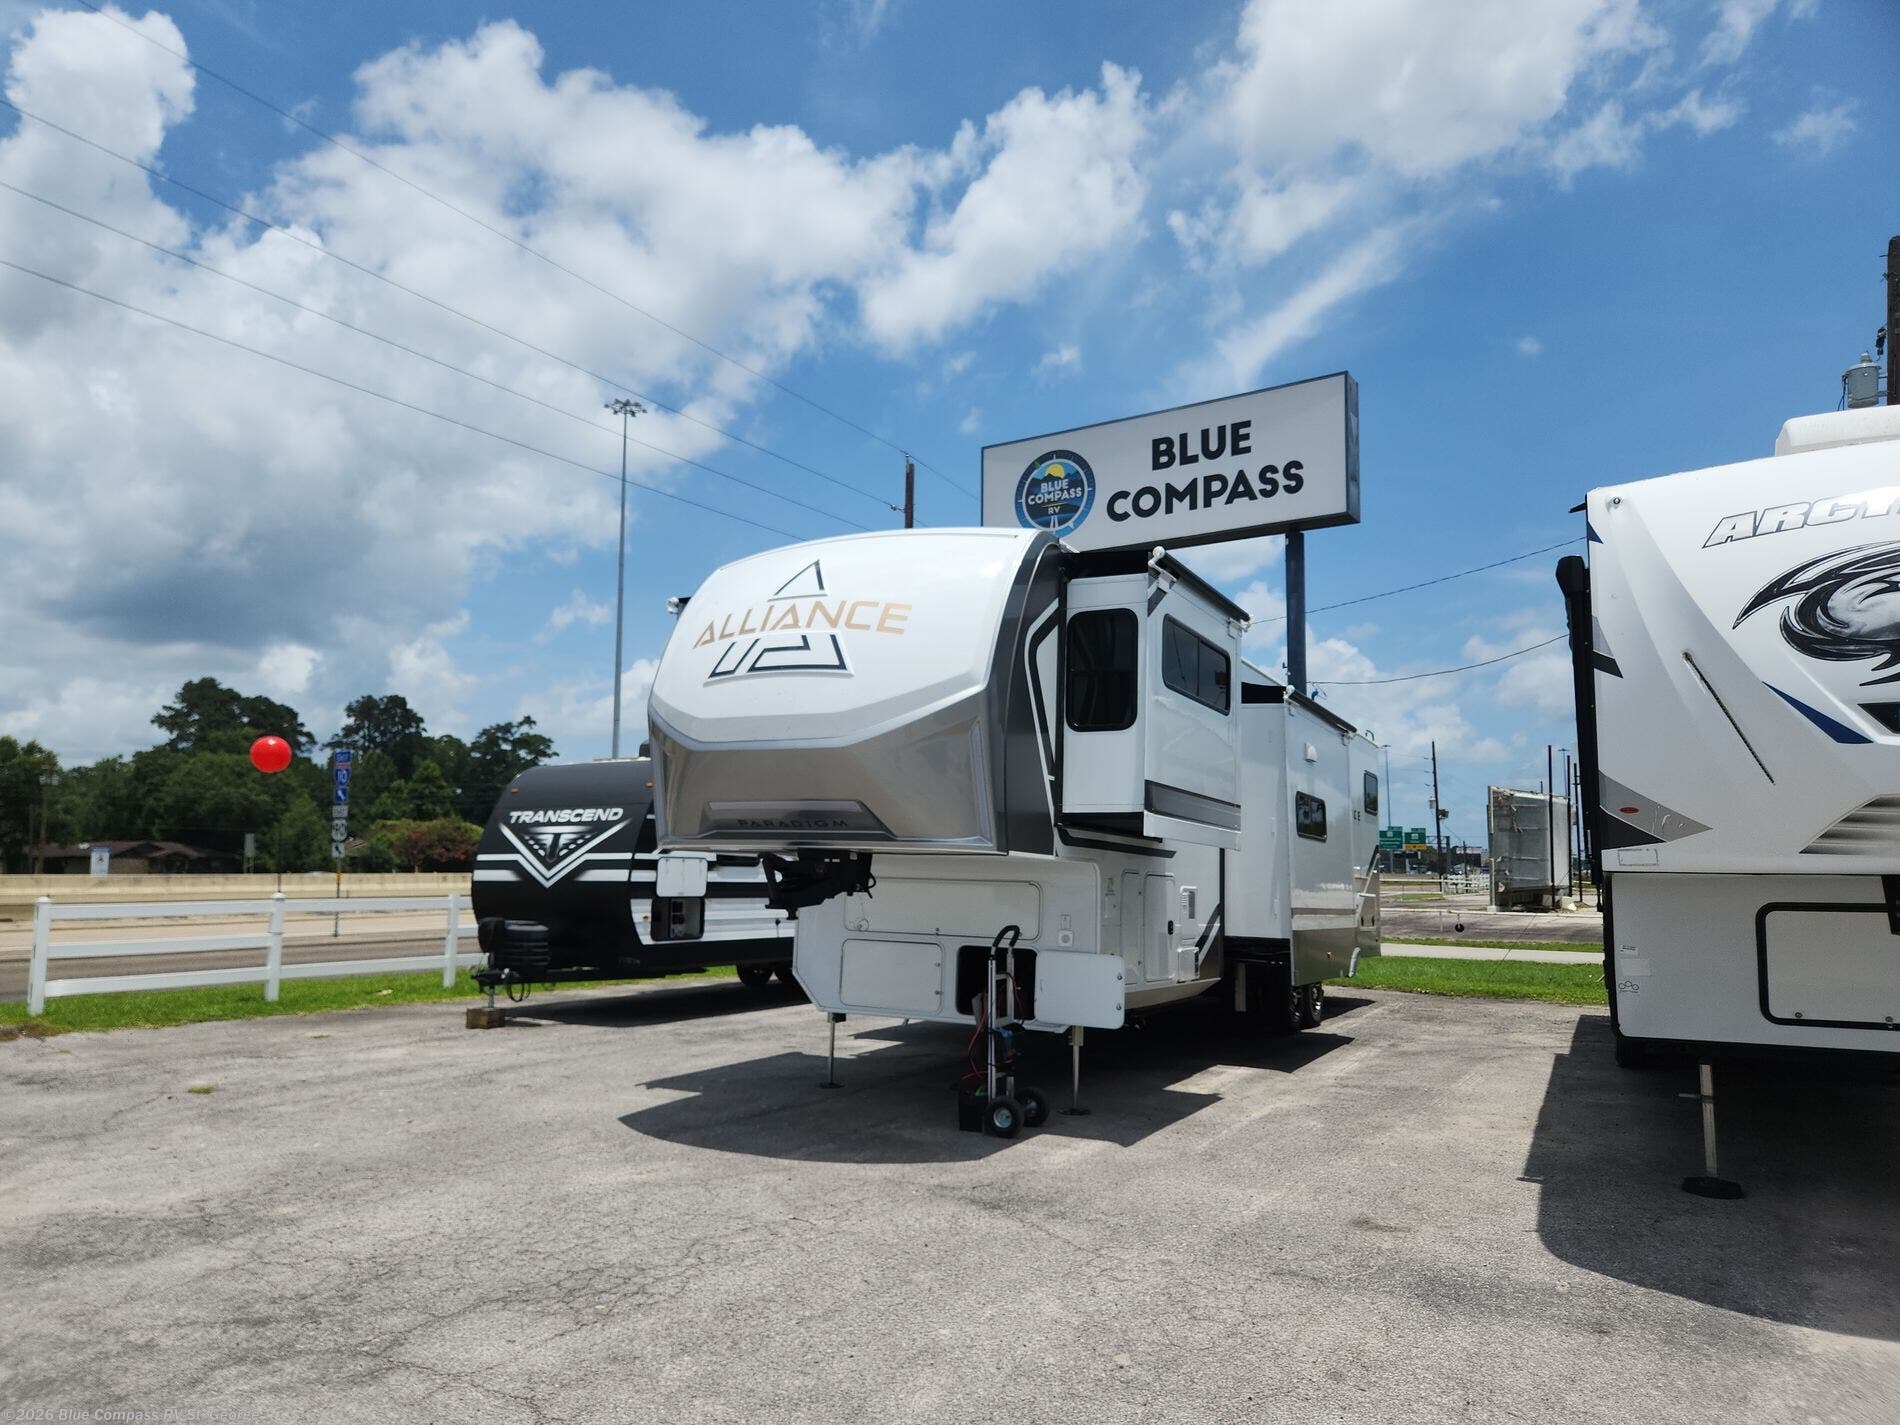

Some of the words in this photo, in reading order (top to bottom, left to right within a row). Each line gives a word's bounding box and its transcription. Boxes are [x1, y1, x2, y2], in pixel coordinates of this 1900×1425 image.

[1151, 420, 1252, 471] BLUE
[1040, 479, 1069, 493] BLUE
[1106, 460, 1304, 522] COMPASS
[1028, 487, 1082, 505] COMPASS
[1048, 506, 1060, 515] RV
[1702, 486, 1900, 549] ARCT
[692, 600, 913, 650] ALLIANCE
[509, 807, 624, 824] TRANSCEND
[737, 819, 848, 829] PARADIGM
